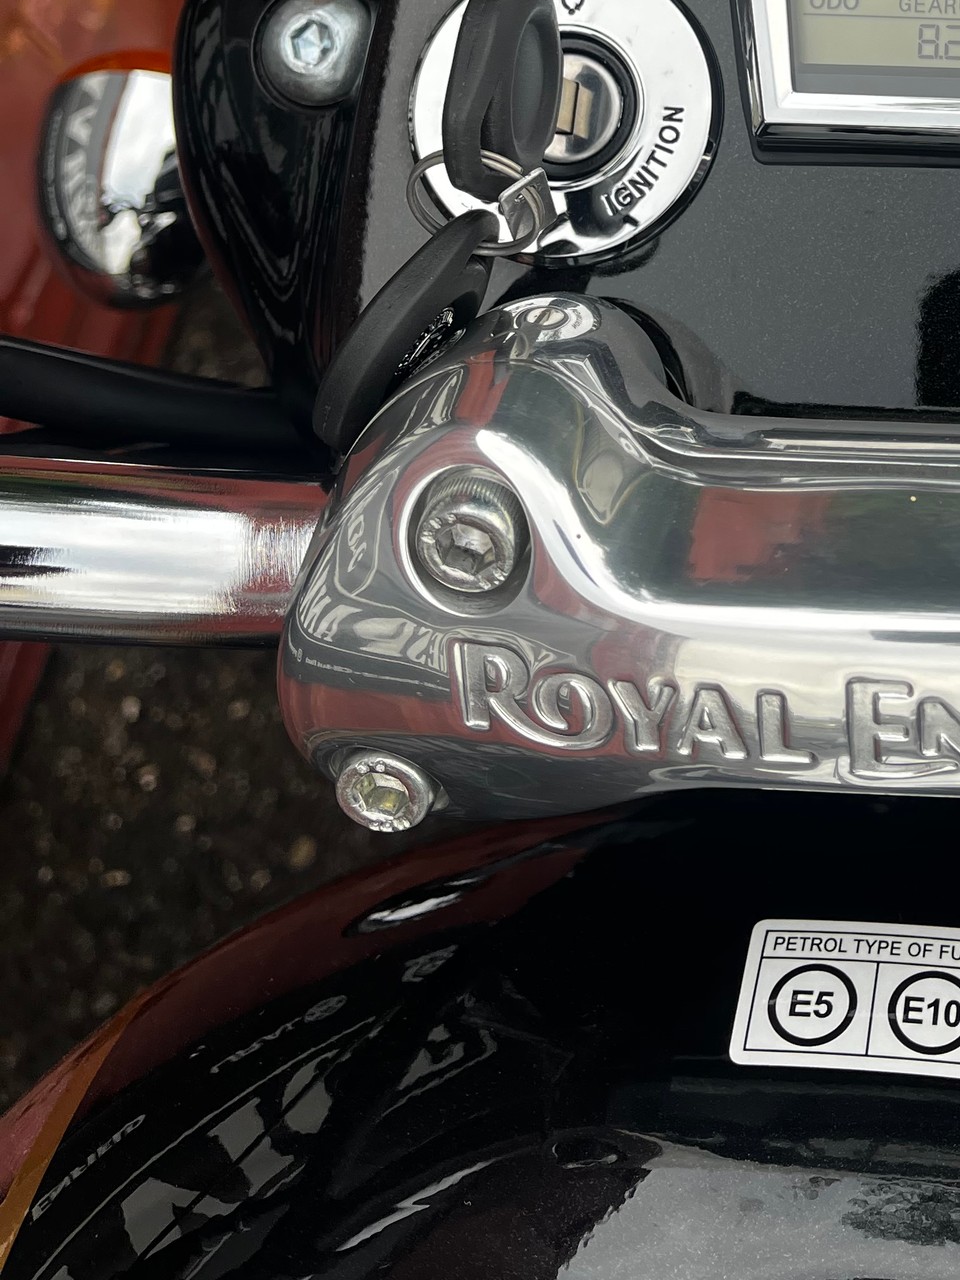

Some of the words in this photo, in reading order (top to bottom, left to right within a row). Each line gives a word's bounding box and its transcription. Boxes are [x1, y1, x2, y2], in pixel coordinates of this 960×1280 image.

[601, 105, 685, 216] IGNITION
[453, 639, 819, 764] ROYAL
[773, 936, 847, 953] PETROL
[853, 939, 902, 956] TYPE
[907, 943, 934, 958] OF
[788, 989, 834, 1019] E5
